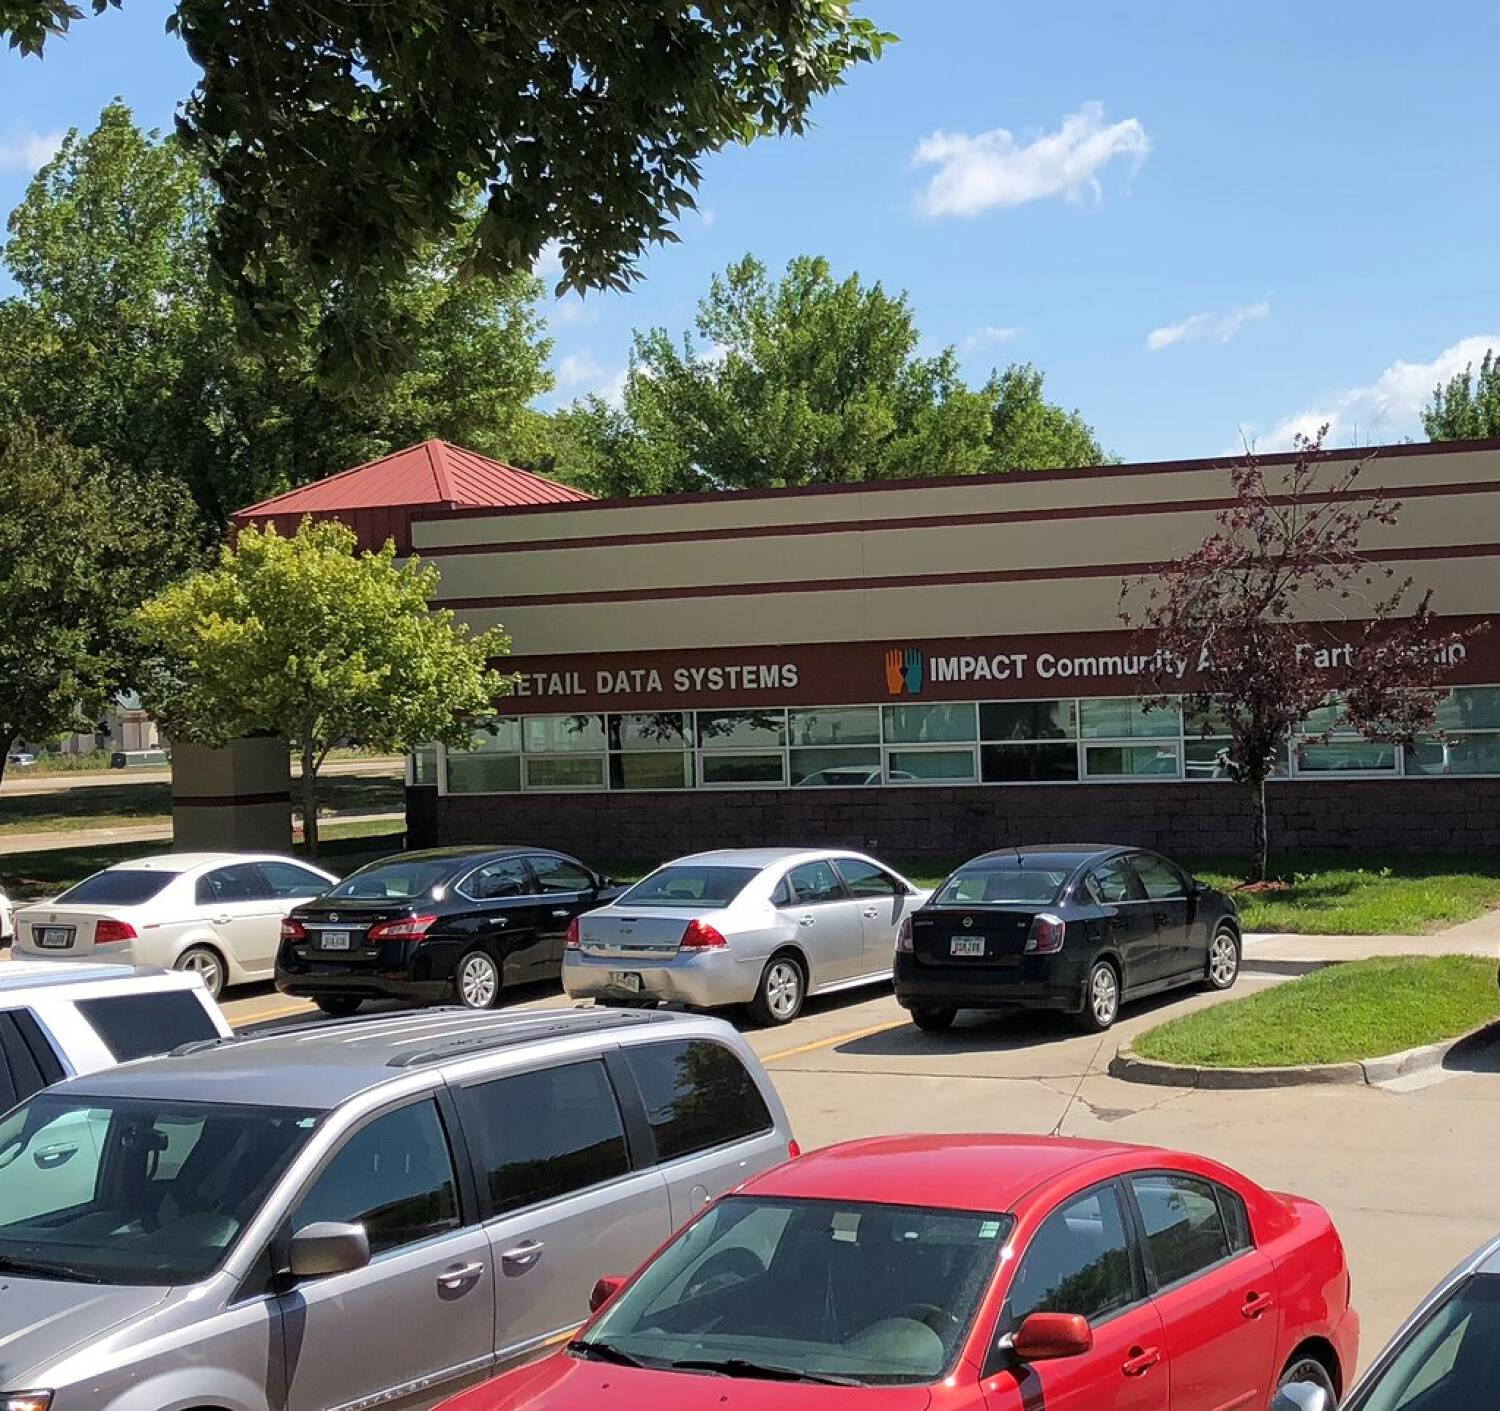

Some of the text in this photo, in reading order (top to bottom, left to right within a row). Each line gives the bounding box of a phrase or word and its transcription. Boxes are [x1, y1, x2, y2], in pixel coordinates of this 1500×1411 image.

[597, 668, 664, 695] DATA
[673, 663, 799, 692] SYSTEMS
[930, 654, 1028, 682] IMPACT
